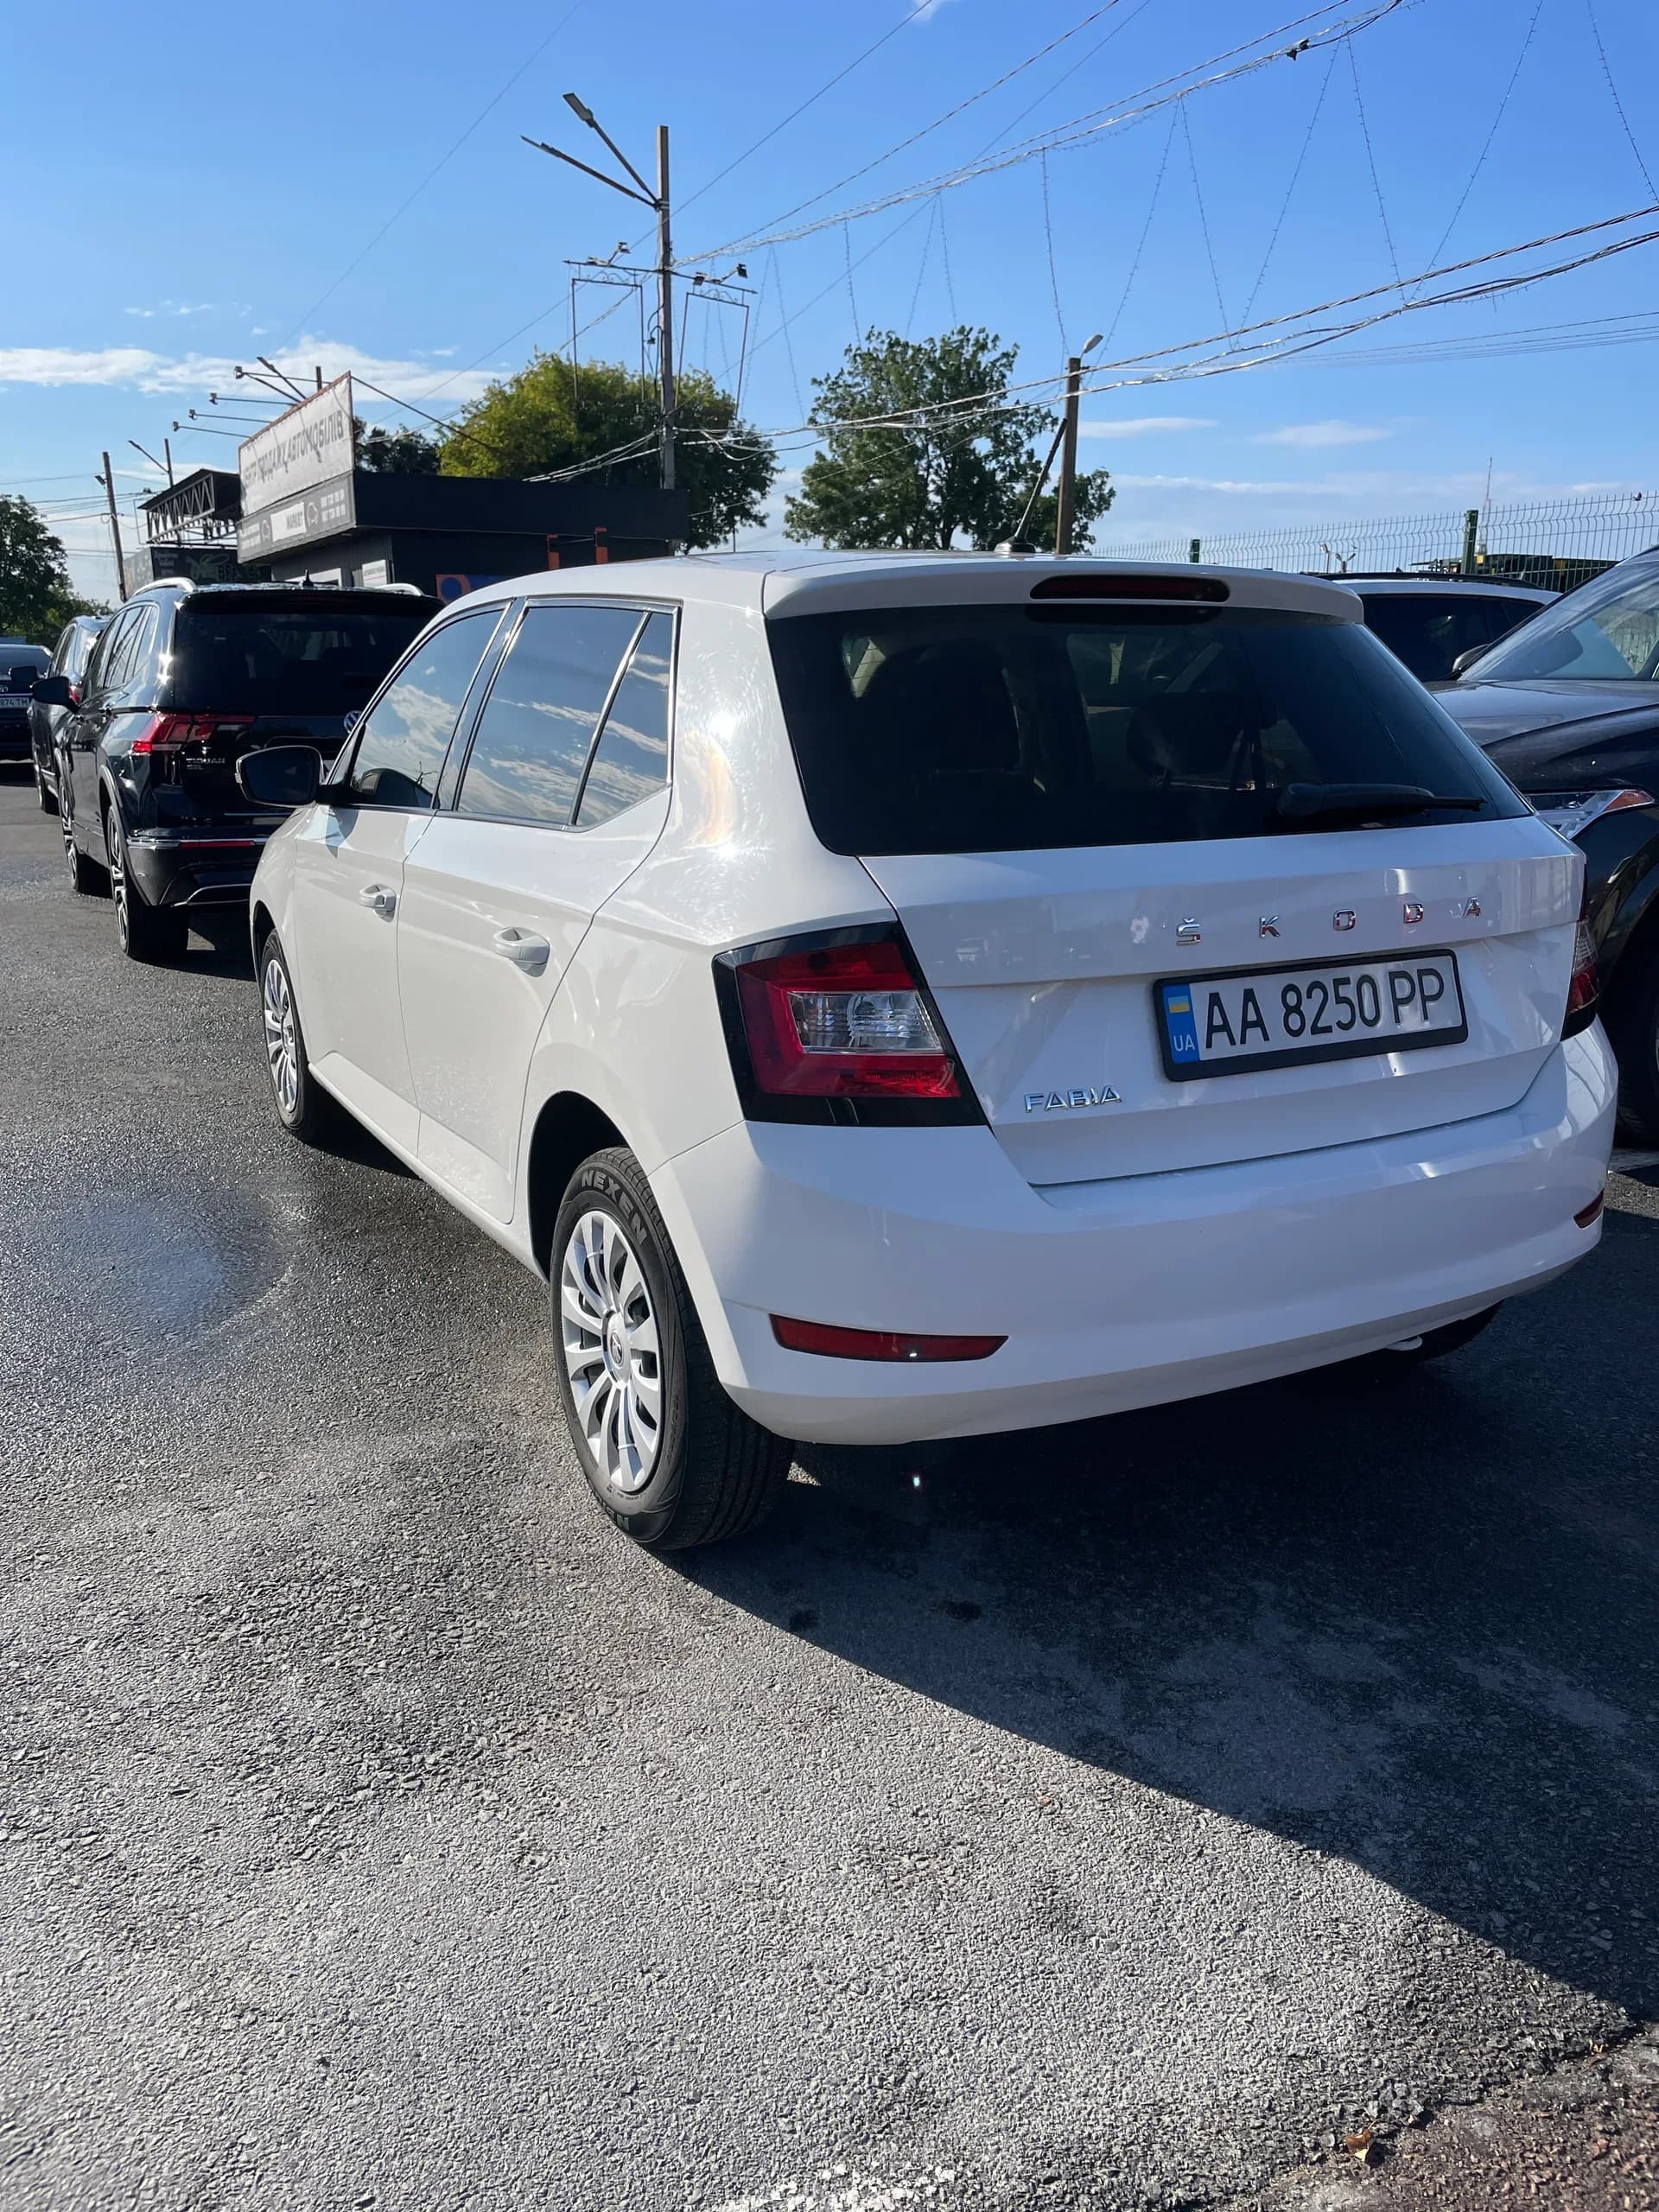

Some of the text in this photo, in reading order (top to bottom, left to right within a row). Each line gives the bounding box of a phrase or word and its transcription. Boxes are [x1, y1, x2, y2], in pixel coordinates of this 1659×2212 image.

[287, 410, 344, 462] АВТОМОБІЛІВ
[1176, 895, 1481, 946] ŠKODA
[1205, 968, 1445, 1049] AA 8250 PP
[1173, 1033, 1196, 1052] UA
[1025, 1084, 1122, 1114] FABIA
[582, 1169, 648, 1245] NEXEN
